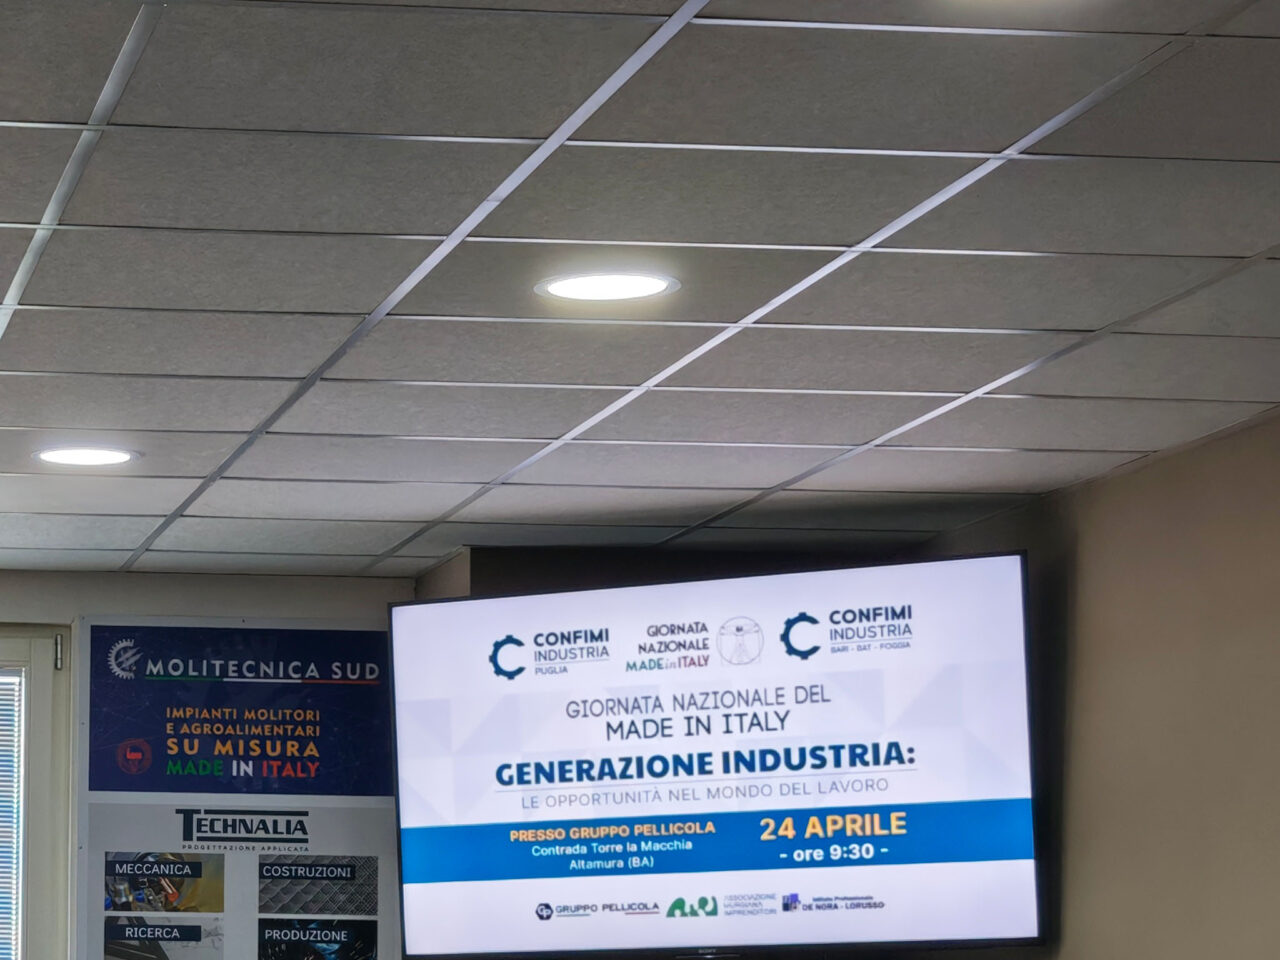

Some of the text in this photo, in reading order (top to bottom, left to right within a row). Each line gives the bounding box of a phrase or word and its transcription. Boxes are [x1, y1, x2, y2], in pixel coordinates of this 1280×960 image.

[829, 605, 912, 625] CONFIMI
[533, 628, 609, 646] CONFIMI
[647, 621, 709, 637] GIORNATA
[830, 623, 912, 641] INDUSTRIA
[534, 646, 609, 662] INDUSTRIA
[638, 638, 710, 655] NAZIONALE
[145, 658, 380, 680] MOLITECNICA SUD
[535, 666, 568, 676] PUGLIA
[566, 684, 831, 719] GIORNATA NAZIONALE DEL
[166, 707, 320, 721] IMPIANTI MOLITORI
[166, 722, 320, 737] E AGROALIMENTARI
[607, 710, 790, 742] MADE IN ITALY
[166, 737, 320, 758] SU MISURA
[166, 759, 320, 778] MADE IN ITALY
[495, 741, 916, 787] GENERAZIONE INDUSTRIA:
[521, 778, 888, 809] LE OPPORTUNITÀ NEL MONDO DEL LAVORO
[175, 808, 309, 843] TECHNALIA
[510, 820, 716, 842] PRESSO GRUPPO PELLICOLA
[759, 812, 907, 842] 24 APRILE
[182, 844, 256, 852] PROGETTAZIONE
[531, 838, 693, 857] Contrada Torre la Macchia
[793, 848, 824, 862] ore
[829, 843, 875, 860] 9:30
[115, 863, 192, 875] MECCANICA
[569, 855, 654, 870] Altamura (BA)
[262, 866, 352, 878] COSTRUZIONI
[555, 904, 598, 914] GRUPPO
[602, 902, 659, 912] PELLICOLA
[802, 903, 814, 911] DE
[816, 902, 839, 911] NORA
[845, 901, 885, 910] LORUSSO
[125, 927, 180, 939] RICERCA
[265, 929, 349, 941] PRODUZIONE
